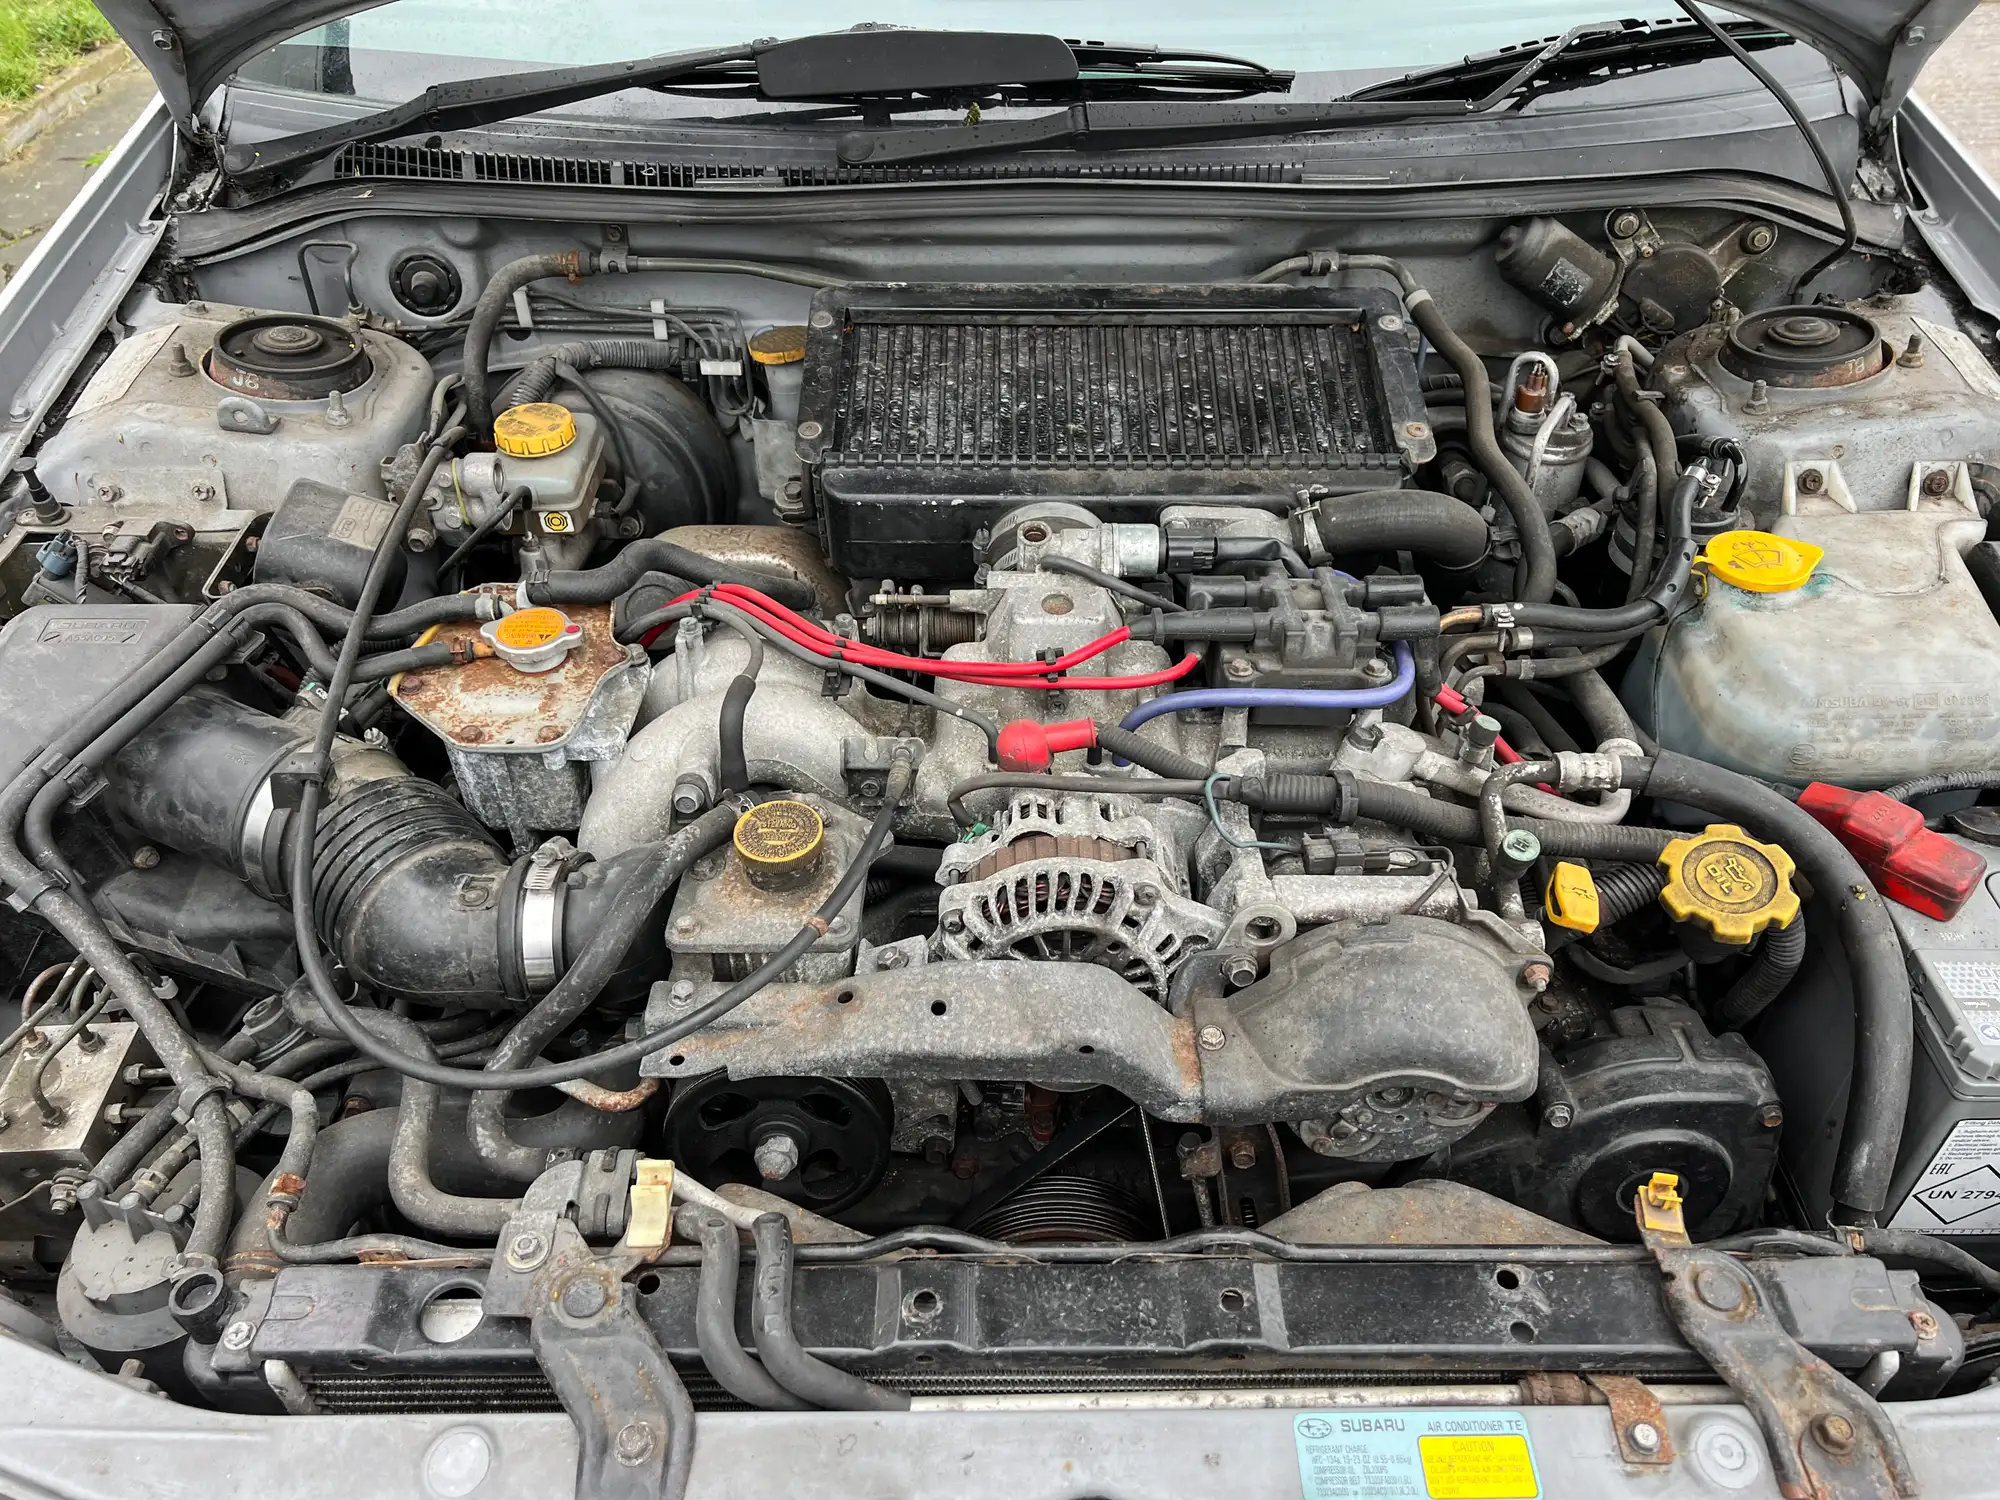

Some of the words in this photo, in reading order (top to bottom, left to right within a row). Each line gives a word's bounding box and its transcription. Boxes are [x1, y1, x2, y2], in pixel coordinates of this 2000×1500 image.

[57, 622, 138, 630] SUBARU
[1513, 838, 1529, 852] H
[1706, 864, 1733, 894] OIL
[1928, 1190, 1957, 1200] UN
[1340, 1418, 1406, 1432] SUBARU
[1428, 1420, 1443, 1432] AIR
[1445, 1420, 1504, 1432] CONDITIONER
[1506, 1419, 1523, 1431] TE
[1452, 1440, 1495, 1452] CAUTION
